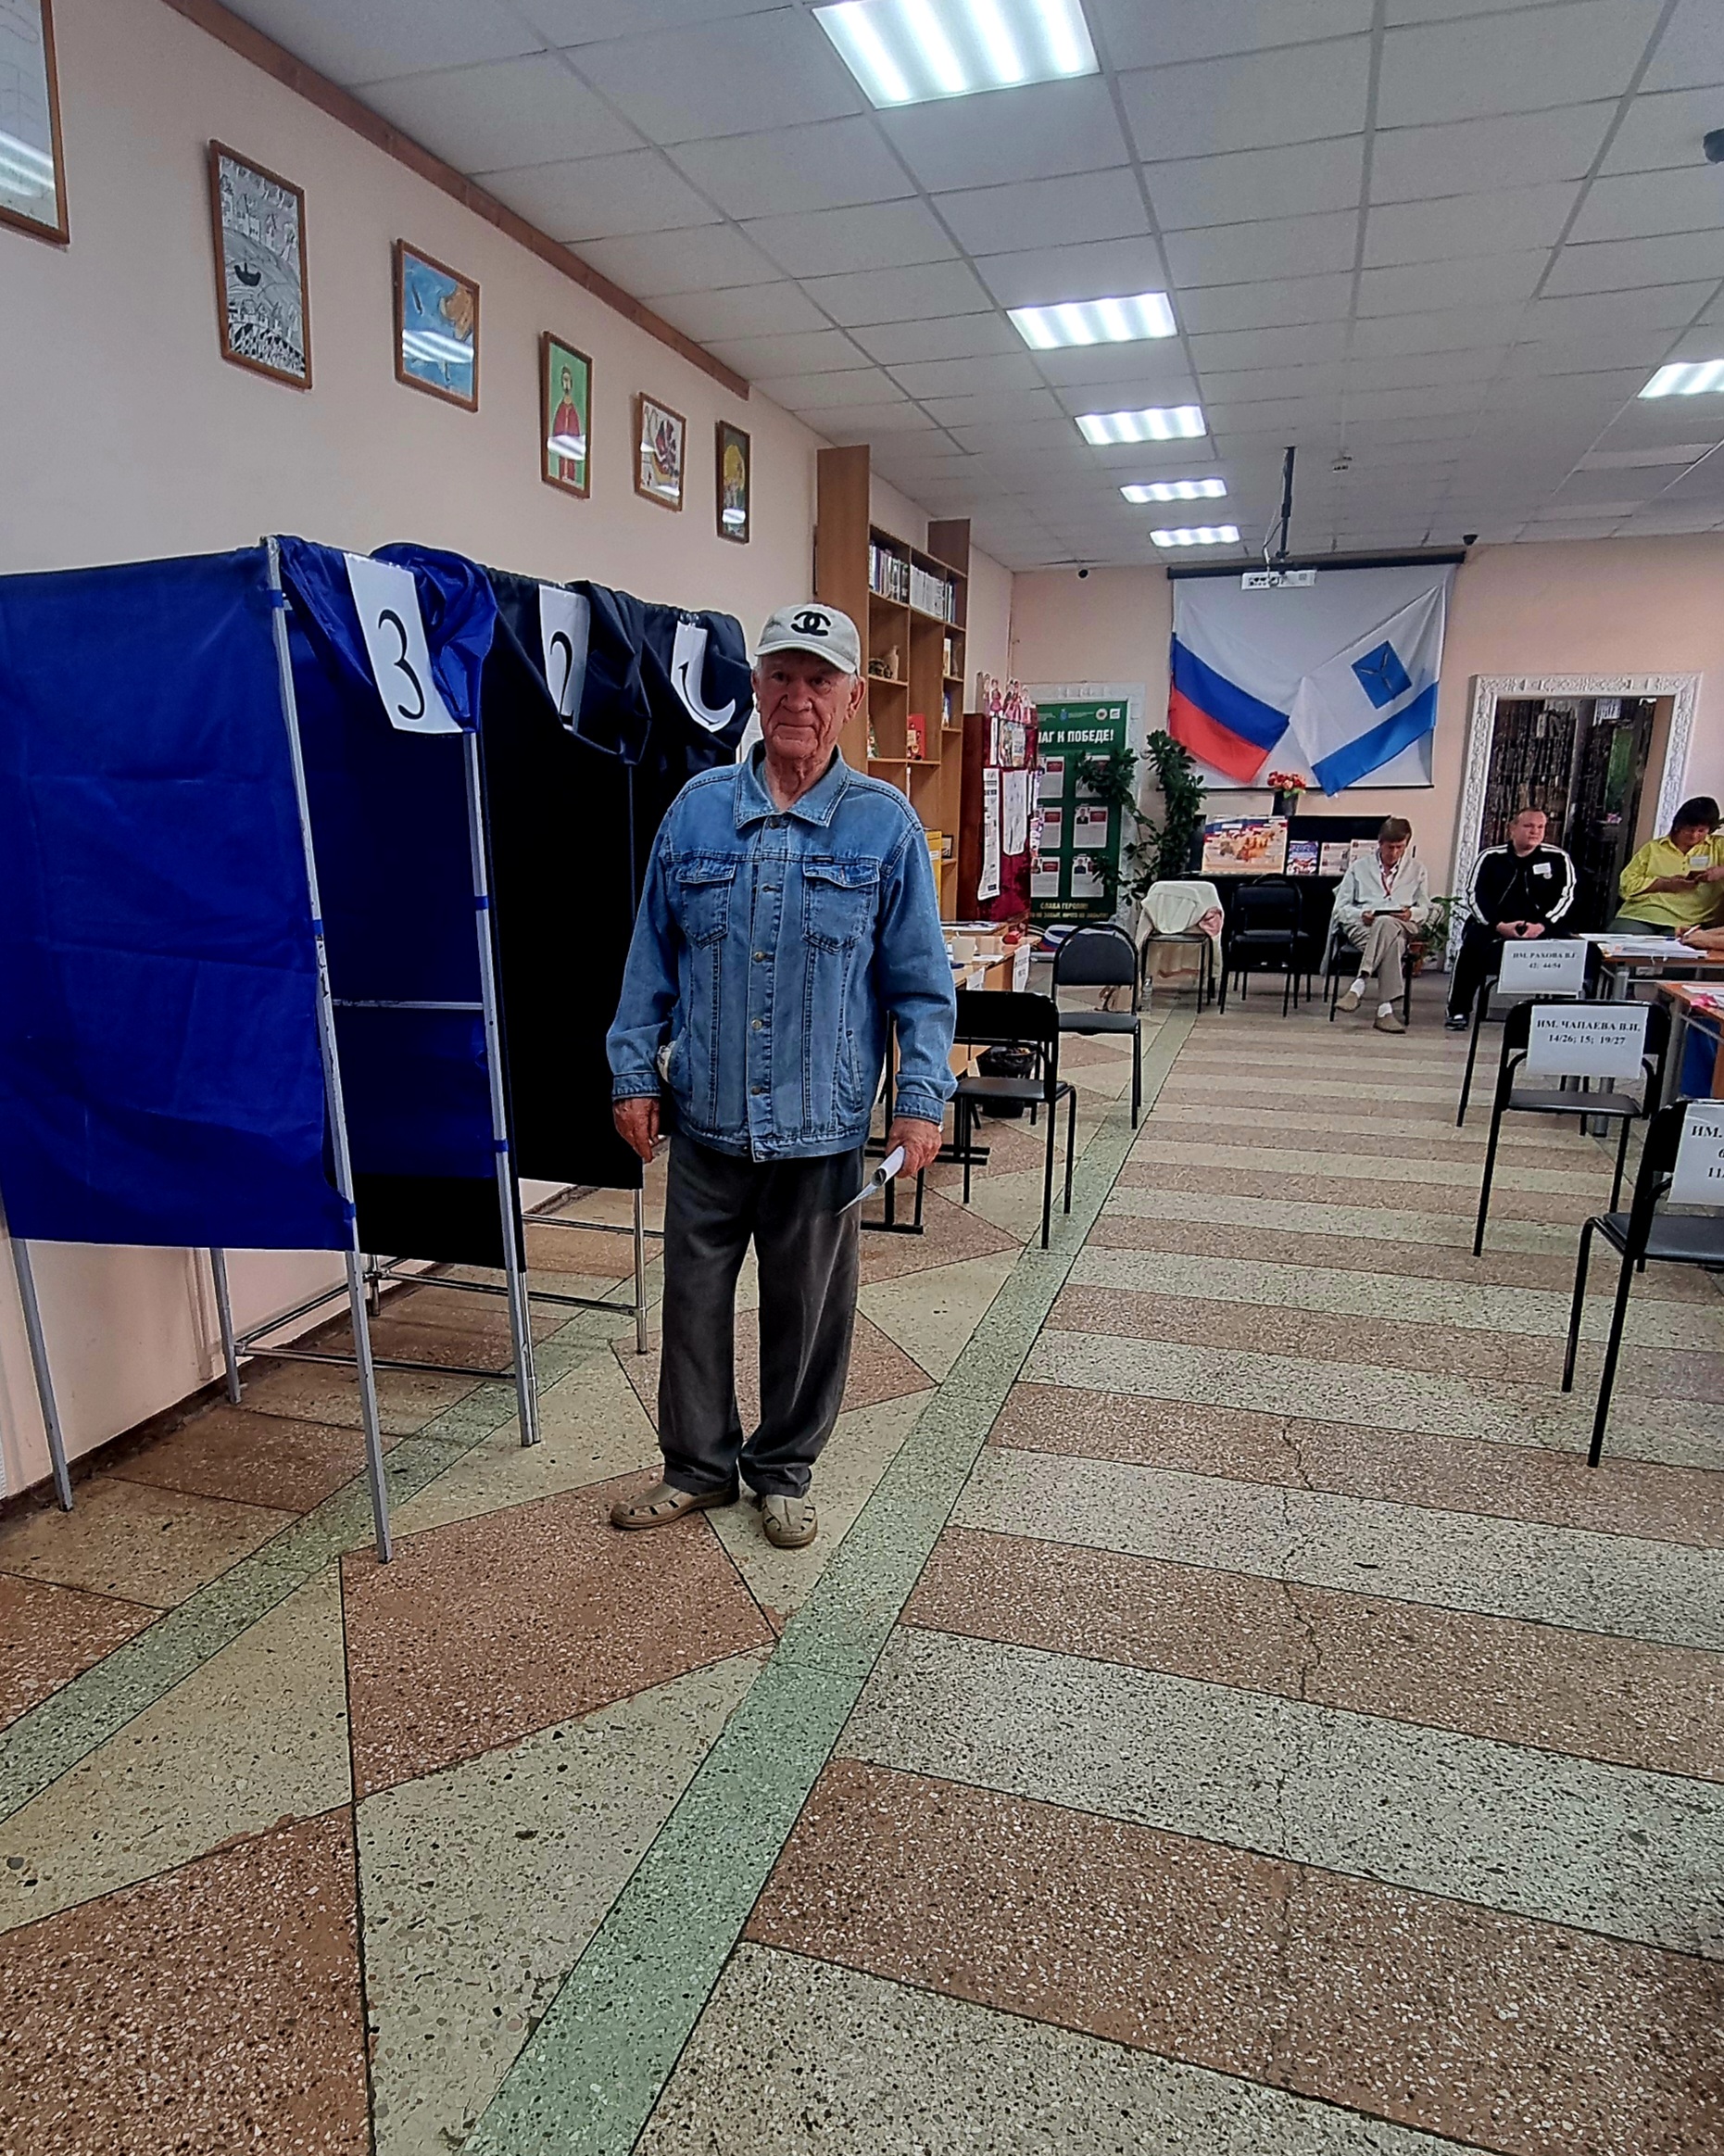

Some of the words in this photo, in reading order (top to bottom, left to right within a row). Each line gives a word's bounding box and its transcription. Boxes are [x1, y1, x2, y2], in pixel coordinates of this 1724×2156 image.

[378, 609, 425, 720] 3
[549, 630, 574, 726] 2
[677, 661, 721, 726] 1
[1057, 731, 1065, 743] К
[1067, 728, 1114, 744] ПОБЕДЕ!
[1537, 1020, 1558, 1028] ИМ.
[1561, 1020, 1616, 1031] ЧАПАЕВА
[1618, 1022, 1641, 1032] В.И.
[1549, 1034, 1577, 1043] 14/26;
[1579, 1035, 1594, 1044] 15;
[1600, 1036, 1626, 1045] 19/27
[1692, 1126, 1723, 1139] ИМ.
[1708, 1167, 1724, 1179] 11
